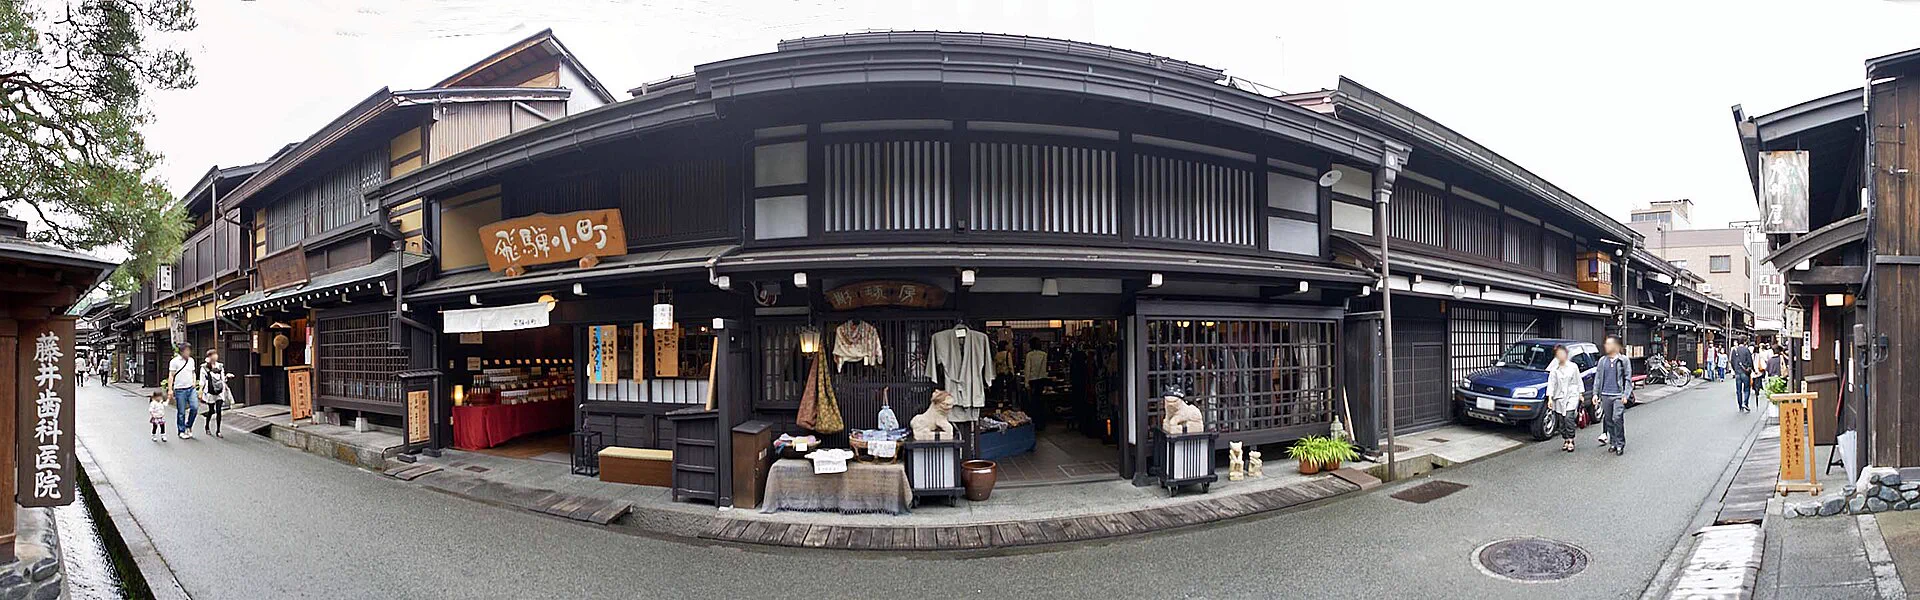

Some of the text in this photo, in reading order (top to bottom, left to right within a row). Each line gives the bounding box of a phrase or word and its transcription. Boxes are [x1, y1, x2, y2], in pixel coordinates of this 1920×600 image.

[494, 218, 609, 263] 飛騨小町
[33, 331, 64, 499] 藤井歯科医院
